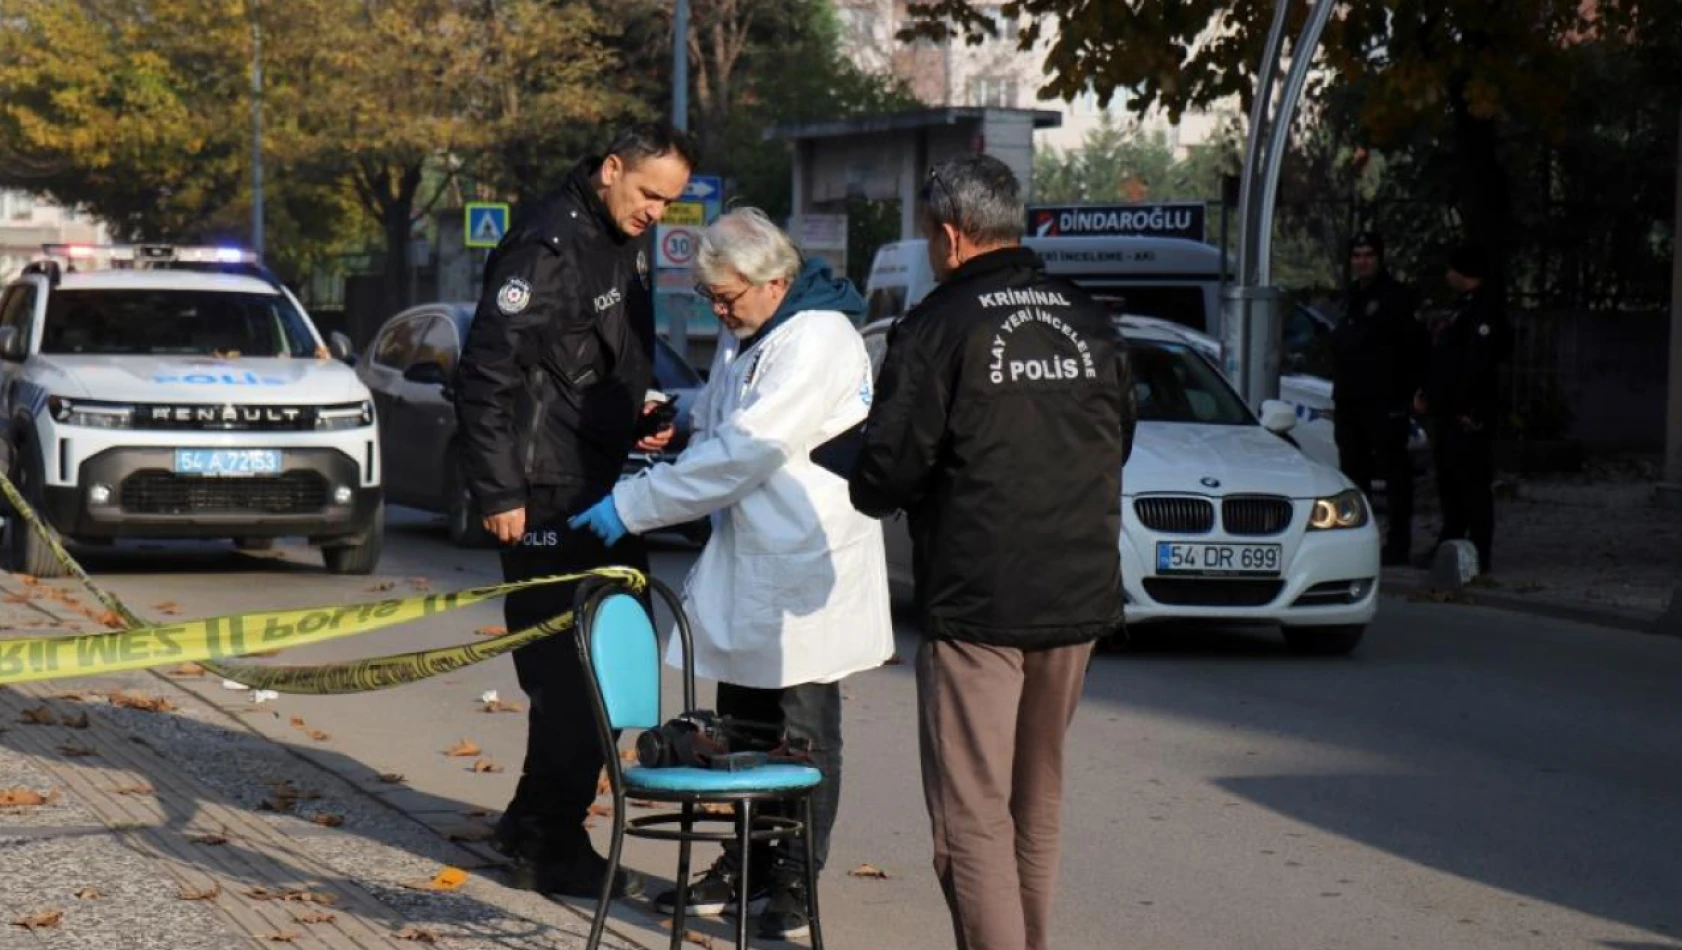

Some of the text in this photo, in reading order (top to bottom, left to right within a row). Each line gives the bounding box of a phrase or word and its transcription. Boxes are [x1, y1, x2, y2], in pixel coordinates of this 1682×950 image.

[1060, 207, 1191, 232] DİNDAROĞLU
[670, 238, 689, 253] 30
[1060, 250, 1124, 262] İNCELEME
[978, 287, 1071, 308] KRİMİNAL
[989, 306, 1096, 384] OLAY YERİ İNCELEME
[1009, 354, 1079, 381] POLİS
[152, 406, 300, 421] RENAULT
[181, 452, 203, 470] 54
[523, 529, 557, 546] OLİS
[1171, 546, 1196, 567] 54
[1203, 547, 1234, 568] DR
[1241, 548, 1277, 569] 699
